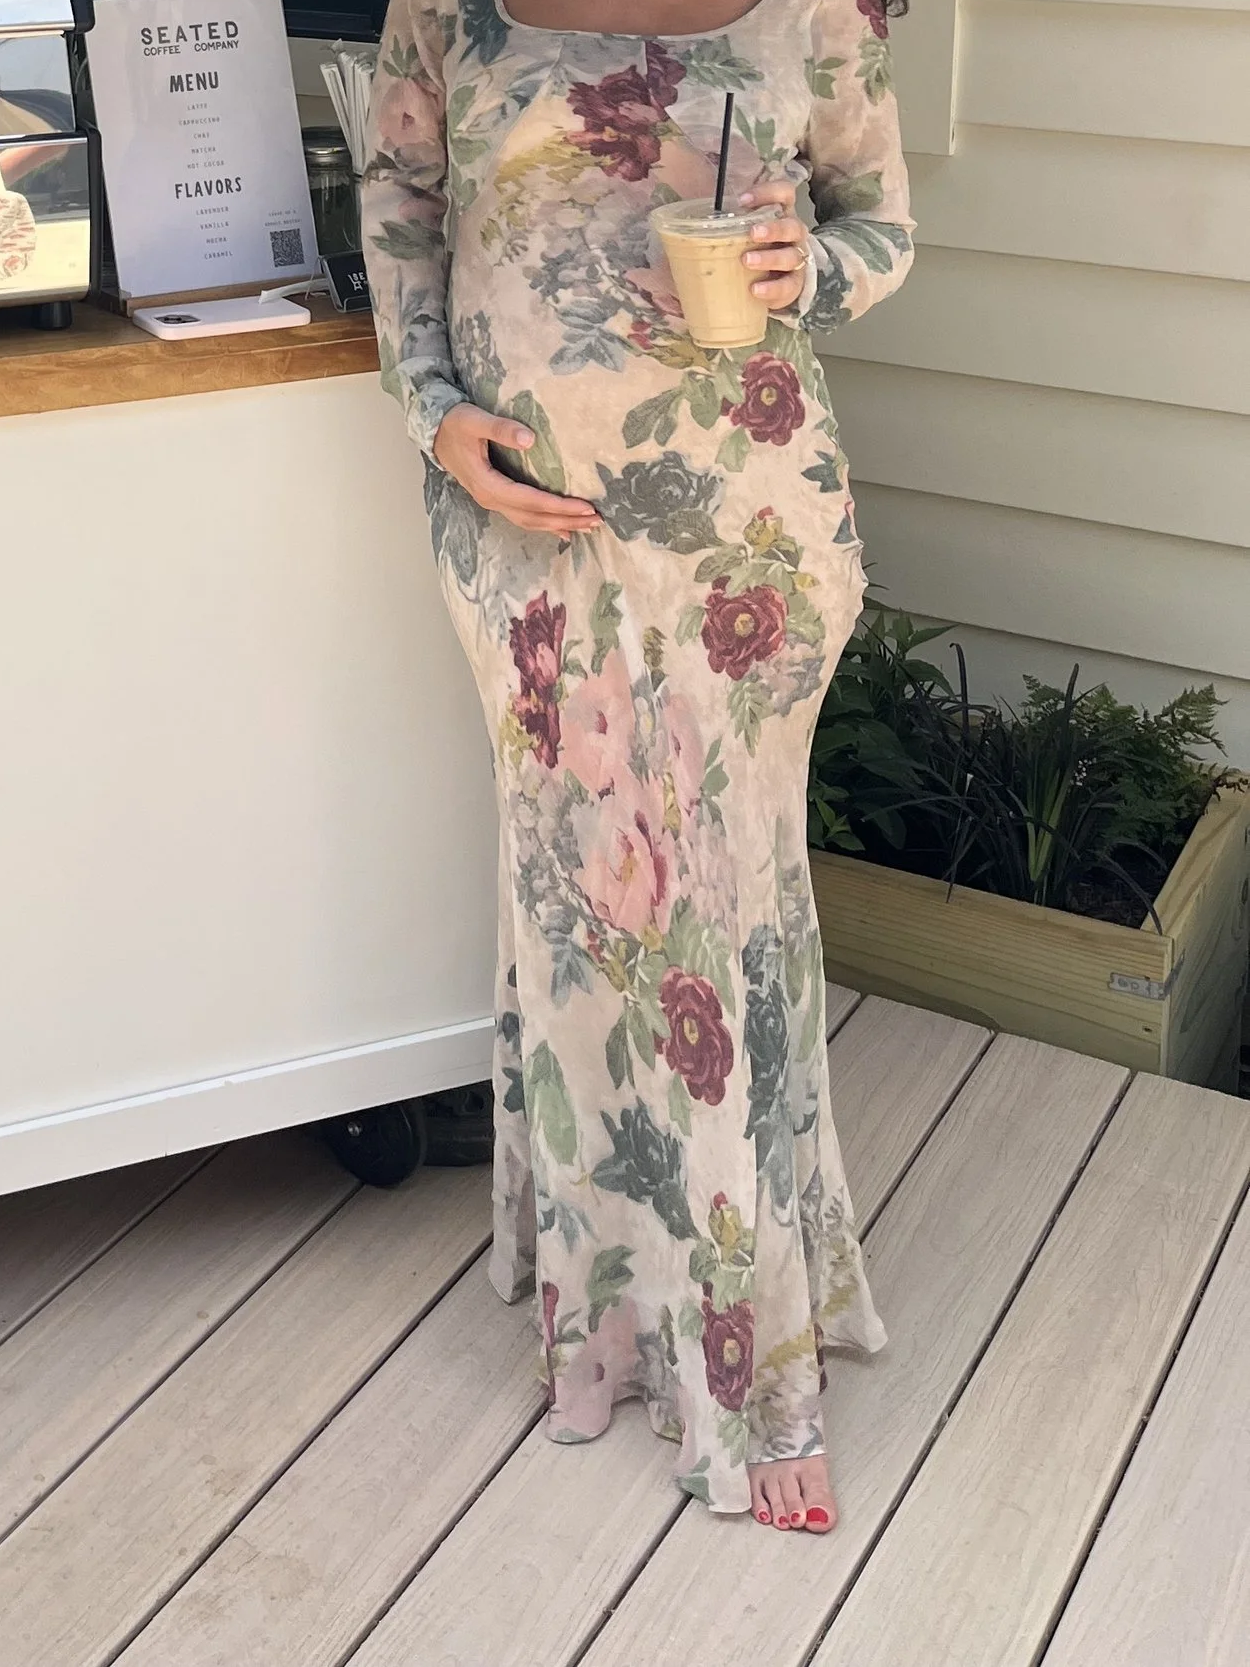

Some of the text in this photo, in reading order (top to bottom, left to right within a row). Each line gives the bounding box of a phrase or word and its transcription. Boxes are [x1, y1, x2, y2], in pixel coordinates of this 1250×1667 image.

[140, 21, 239, 45] SEATED
[143, 40, 239, 56] COFFEE COMPANY
[169, 71, 219, 93] MENU
[174, 176, 242, 200] FLAVORS
